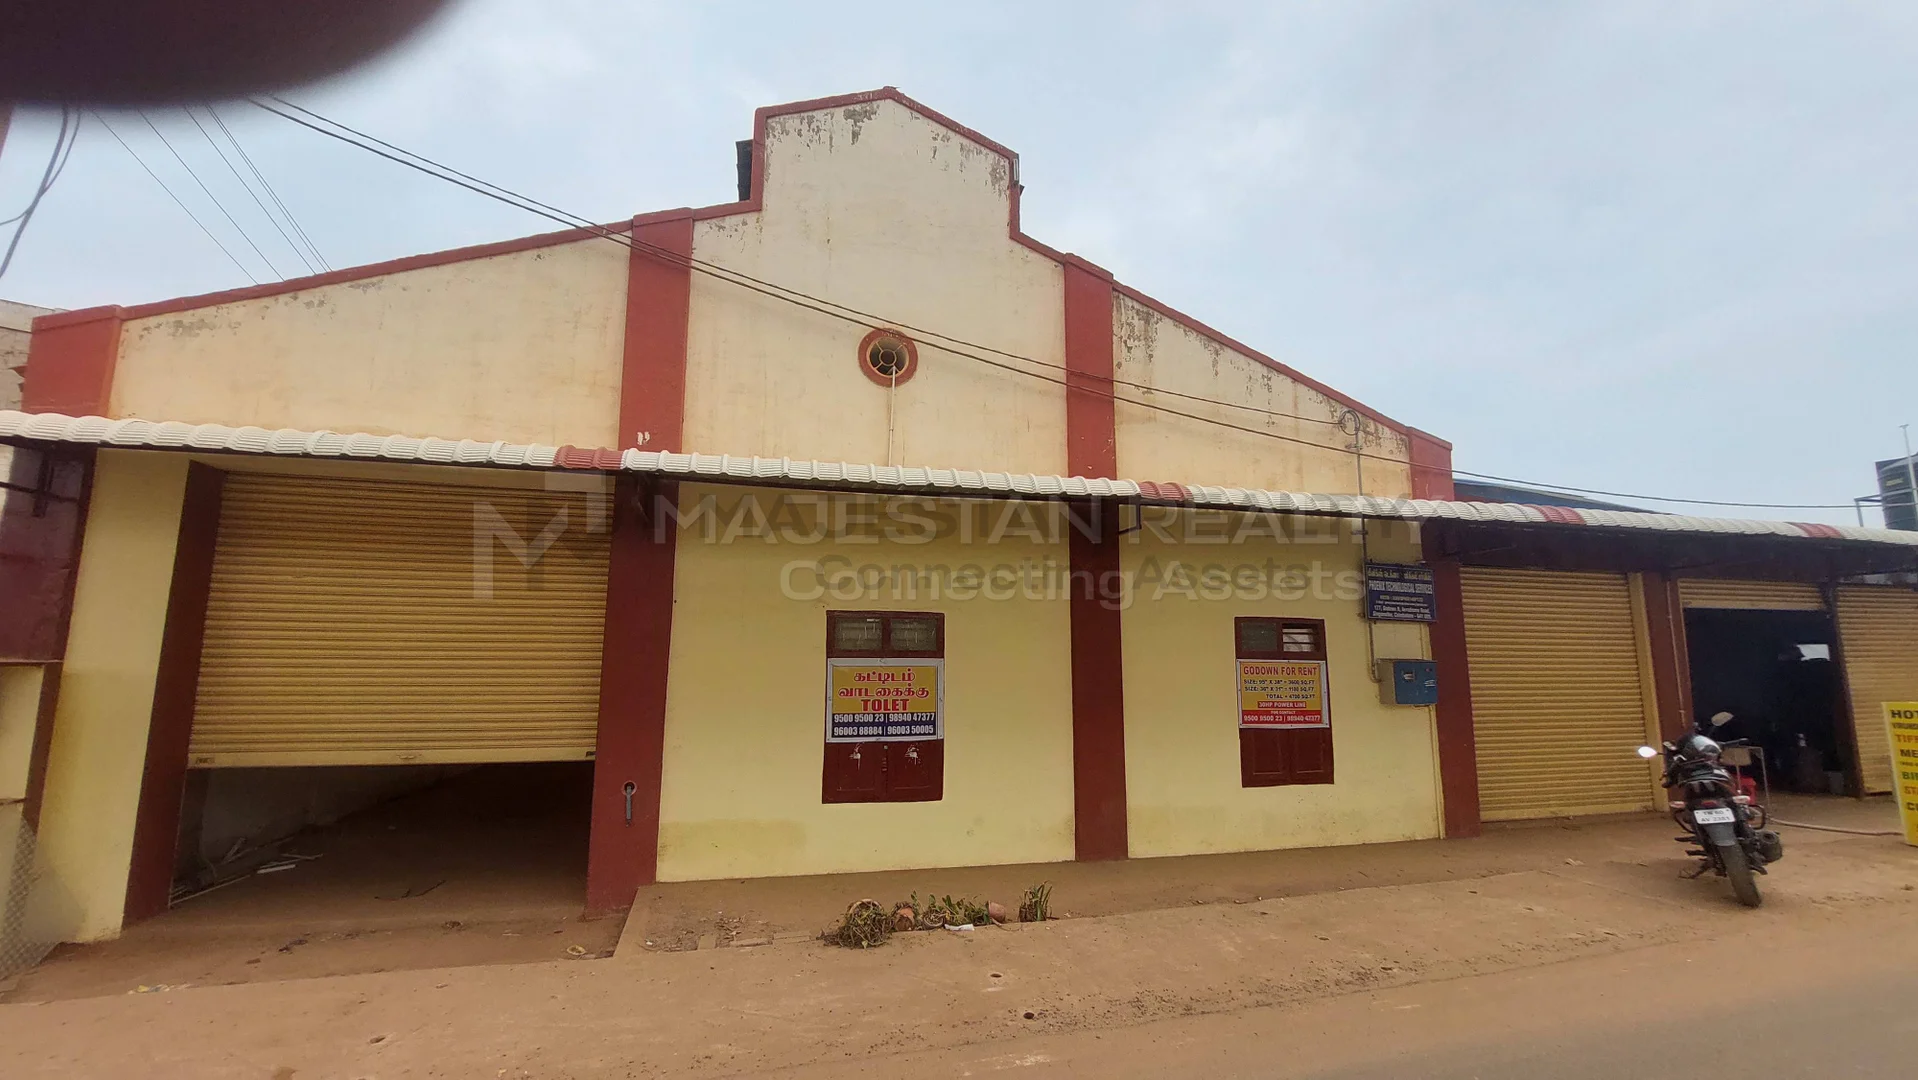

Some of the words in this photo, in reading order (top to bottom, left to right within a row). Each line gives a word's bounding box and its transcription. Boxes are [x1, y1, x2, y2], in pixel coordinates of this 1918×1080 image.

[853, 668, 915, 684] கட்டிடம்
[1243, 666, 1279, 675] GODOWN
[1281, 666, 1297, 676] FOR
[1298, 666, 1317, 676] RENT
[838, 683, 929, 698] வாடகைக்கு
[861, 699, 910, 712] TOLET
[834, 714, 853, 723] 9500
[854, 714, 873, 723] 9500
[875, 714, 884, 722] 23
[889, 713, 912, 722] 98940
[913, 712, 935, 722] 47377
[834, 727, 858, 736] 96003
[887, 725, 910, 735] 96003
[911, 725, 934, 734] 50005
